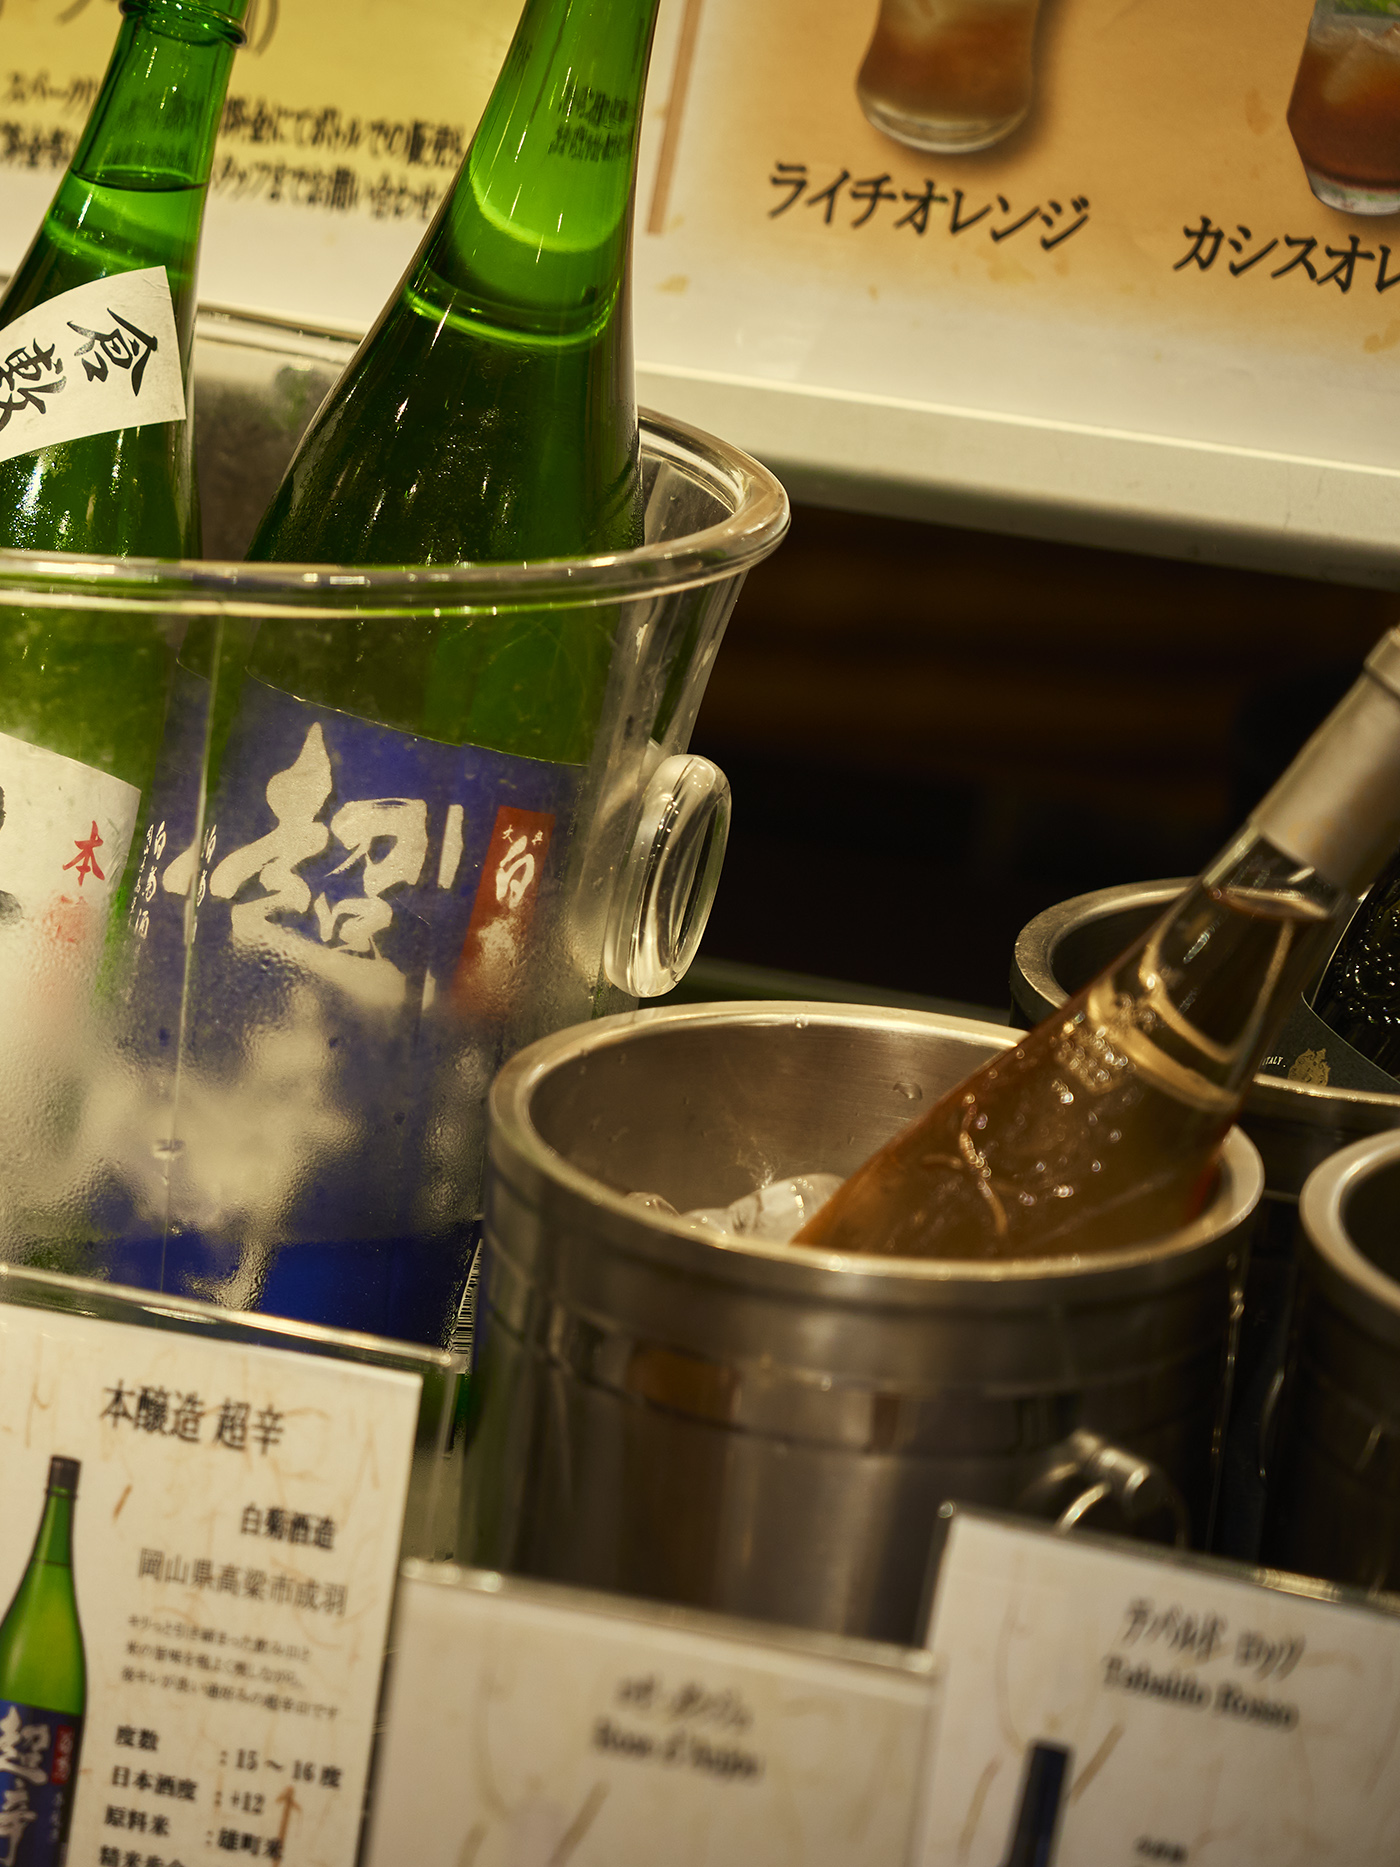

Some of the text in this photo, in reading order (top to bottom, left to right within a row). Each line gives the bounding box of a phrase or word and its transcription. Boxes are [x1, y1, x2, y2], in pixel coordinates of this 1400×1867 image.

[769, 162, 1089, 250] ライチオレンジ
[100, 1379, 285, 1457] 本醸造 超辛
[115, 1724, 160, 1752] 度数
[111, 1764, 198, 1802] 日本酒度
[104, 1803, 171, 1838] 原料米
